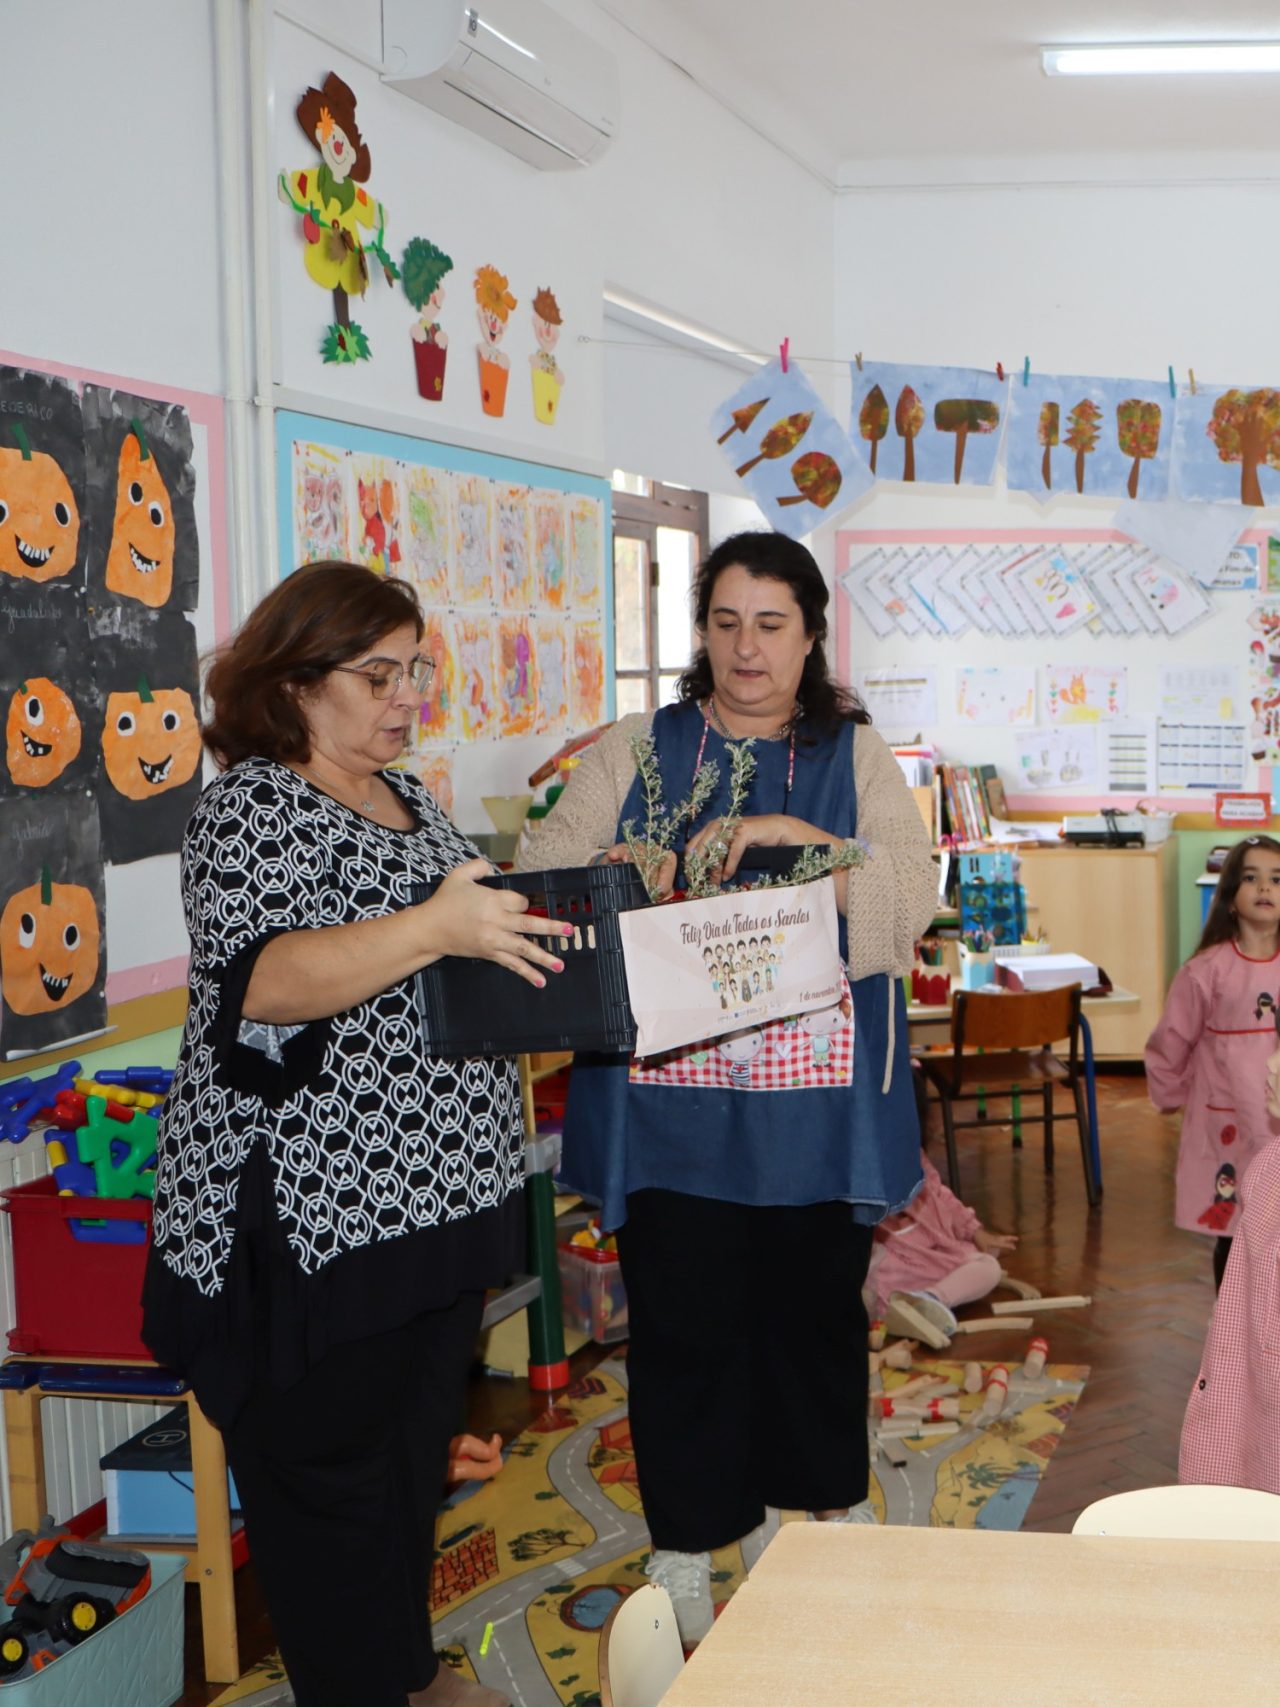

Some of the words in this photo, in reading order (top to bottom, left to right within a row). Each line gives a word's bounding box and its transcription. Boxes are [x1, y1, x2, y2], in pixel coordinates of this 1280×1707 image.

[680, 923, 702, 947] Feliz
[703, 920, 721, 941] Dia
[722, 918, 733, 935] de
[733, 913, 759, 935] Todos
[761, 917, 773, 929] os
[775, 907, 810, 928] Santos
